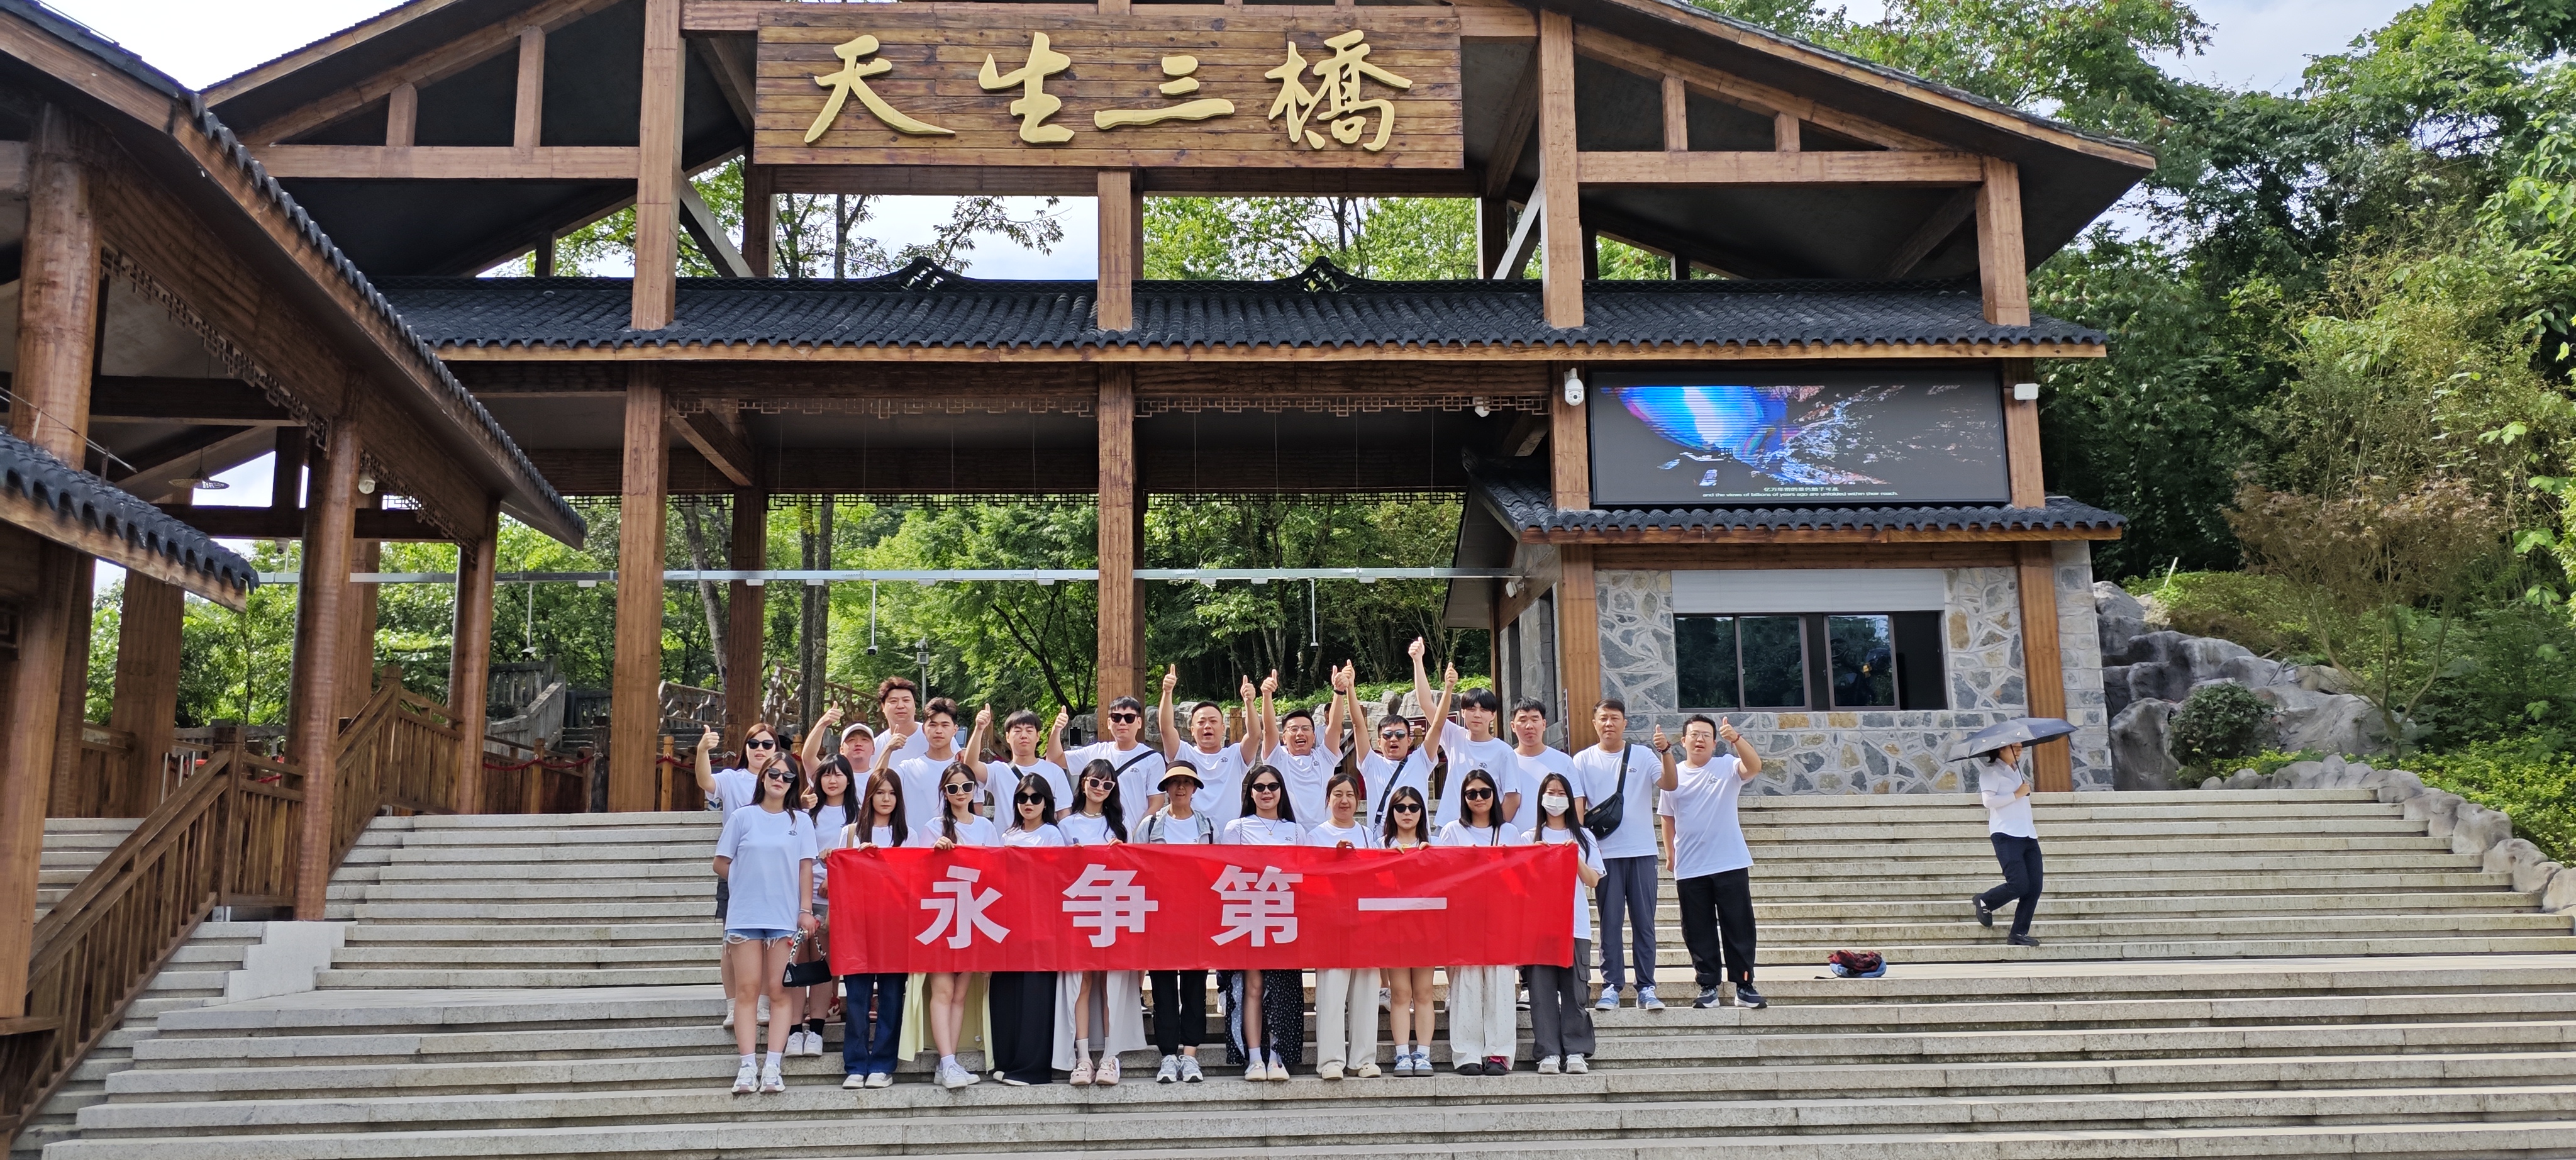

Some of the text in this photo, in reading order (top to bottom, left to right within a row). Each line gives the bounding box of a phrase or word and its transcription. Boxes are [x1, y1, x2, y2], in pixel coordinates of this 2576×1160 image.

[804, 29, 1413, 152] 天生三橋
[916, 864, 1447, 949] 永争第一
